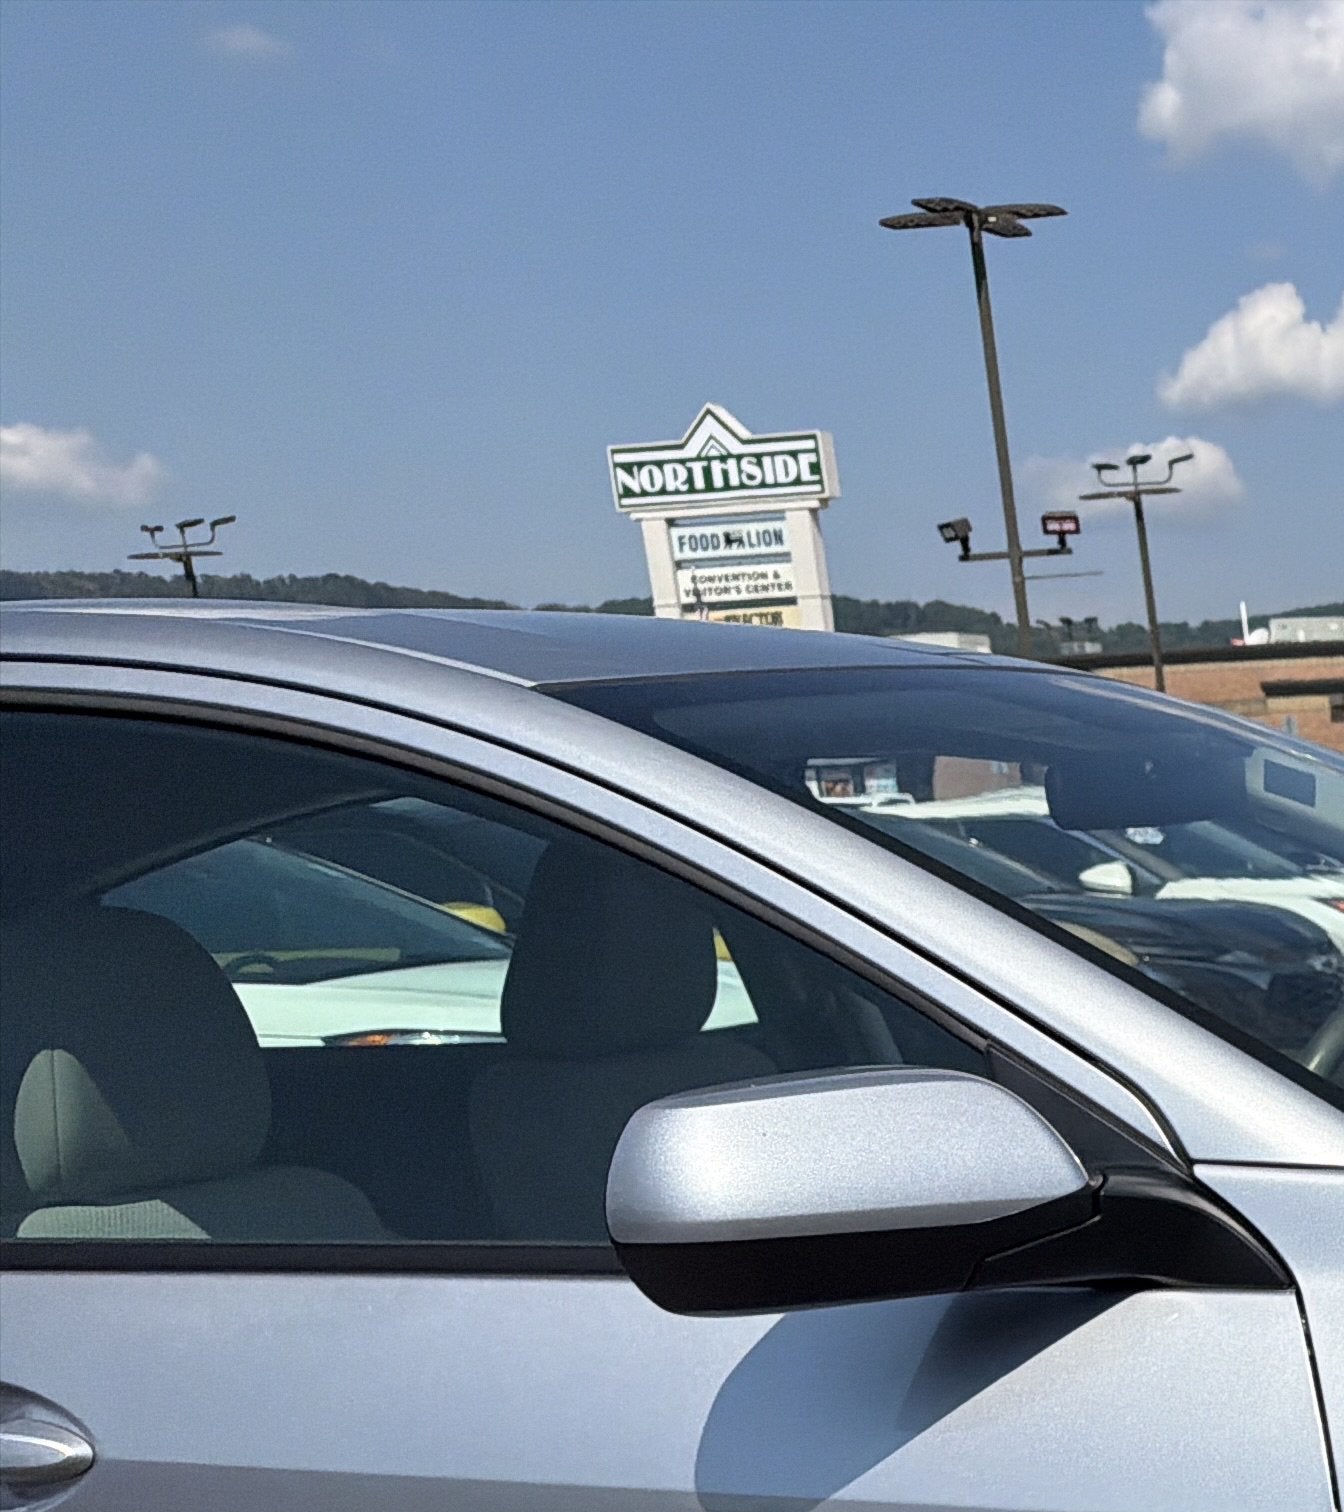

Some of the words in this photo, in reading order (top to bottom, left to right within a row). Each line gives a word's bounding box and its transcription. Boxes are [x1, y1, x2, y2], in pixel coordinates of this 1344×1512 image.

[615, 453, 820, 494] NORTHSIDE
[678, 532, 721, 554] FOOD
[746, 528, 784, 549] LION
[691, 571, 768, 584] ONVENTION
